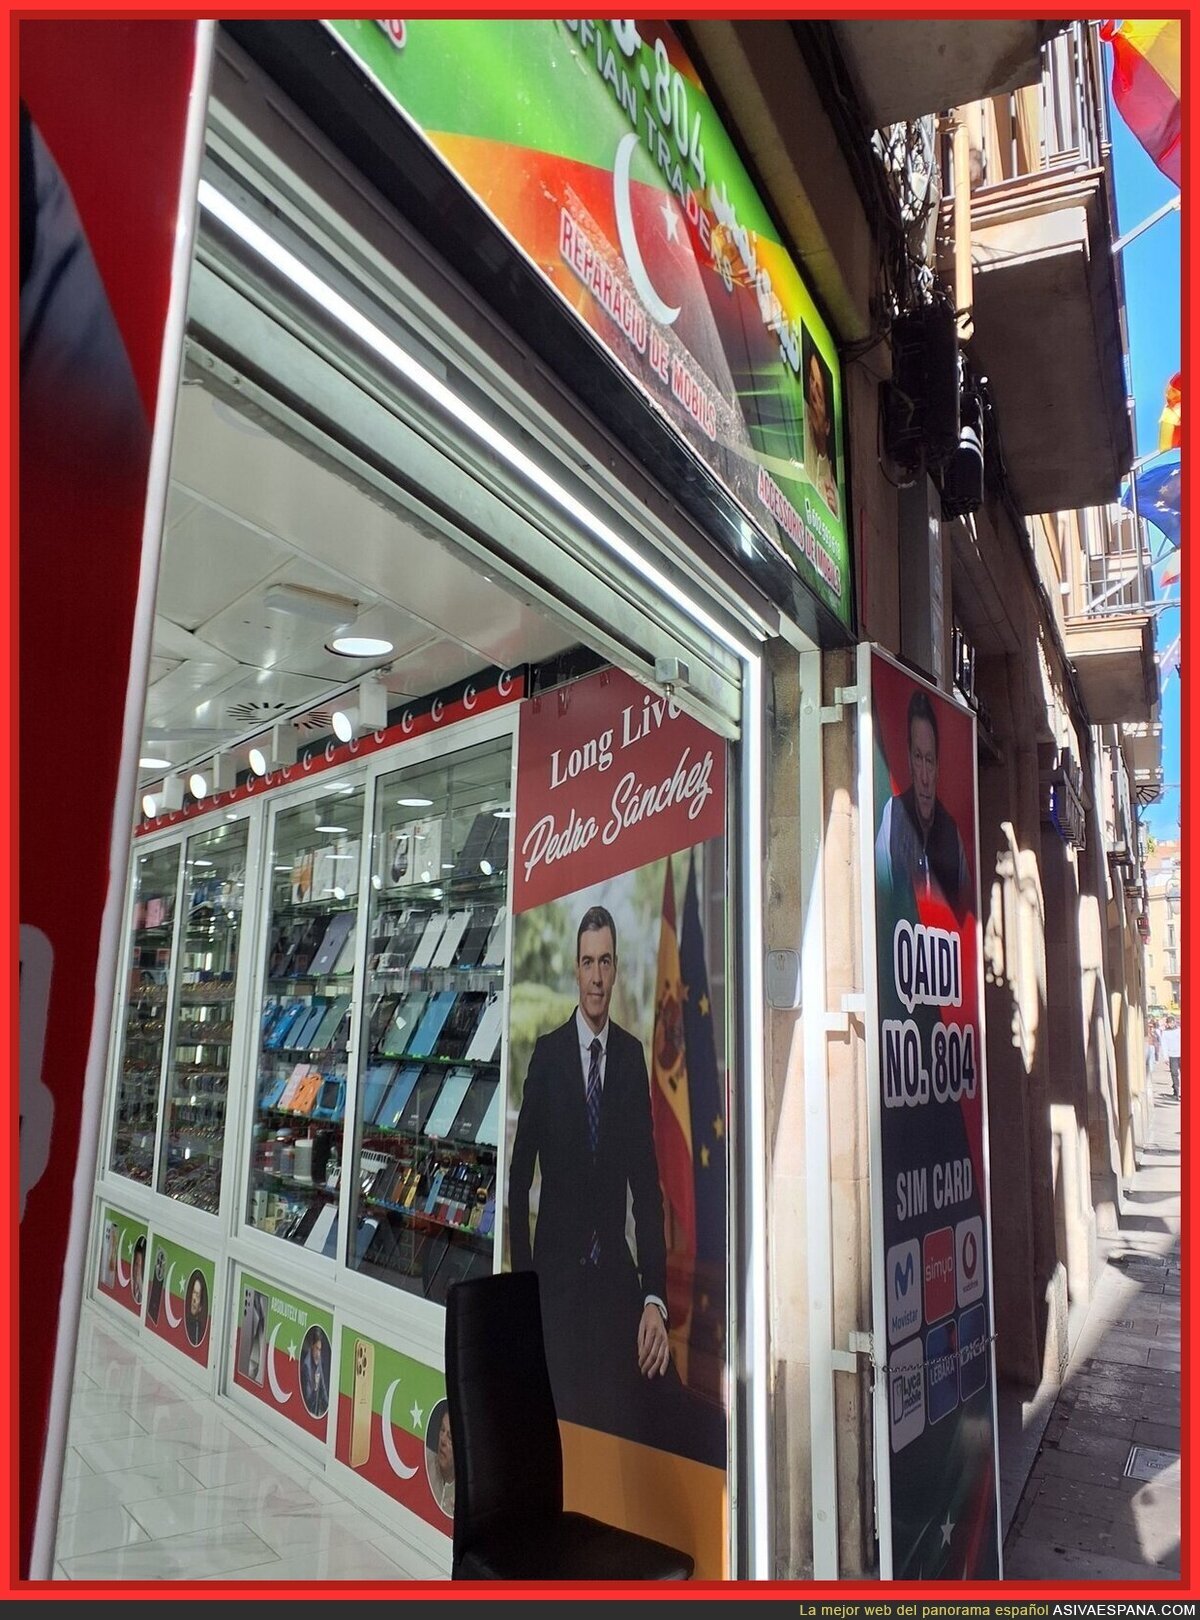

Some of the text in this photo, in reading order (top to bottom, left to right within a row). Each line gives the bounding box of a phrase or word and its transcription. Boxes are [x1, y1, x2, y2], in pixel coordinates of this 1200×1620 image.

[650, 329, 668, 384] DE
[550, 728, 614, 790] Long
[522, 747, 714, 882] Pedro Sánchez
[895, 921, 961, 1011] QAIDI
[884, 1023, 975, 1105] NO. 804
[896, 1157, 973, 1221] SIM CARD
[925, 1255, 953, 1283] simyo
[891, 1309, 919, 1332] Movistar
[903, 1371, 921, 1396] Lyca
[929, 1358, 955, 1386] LEBARA
